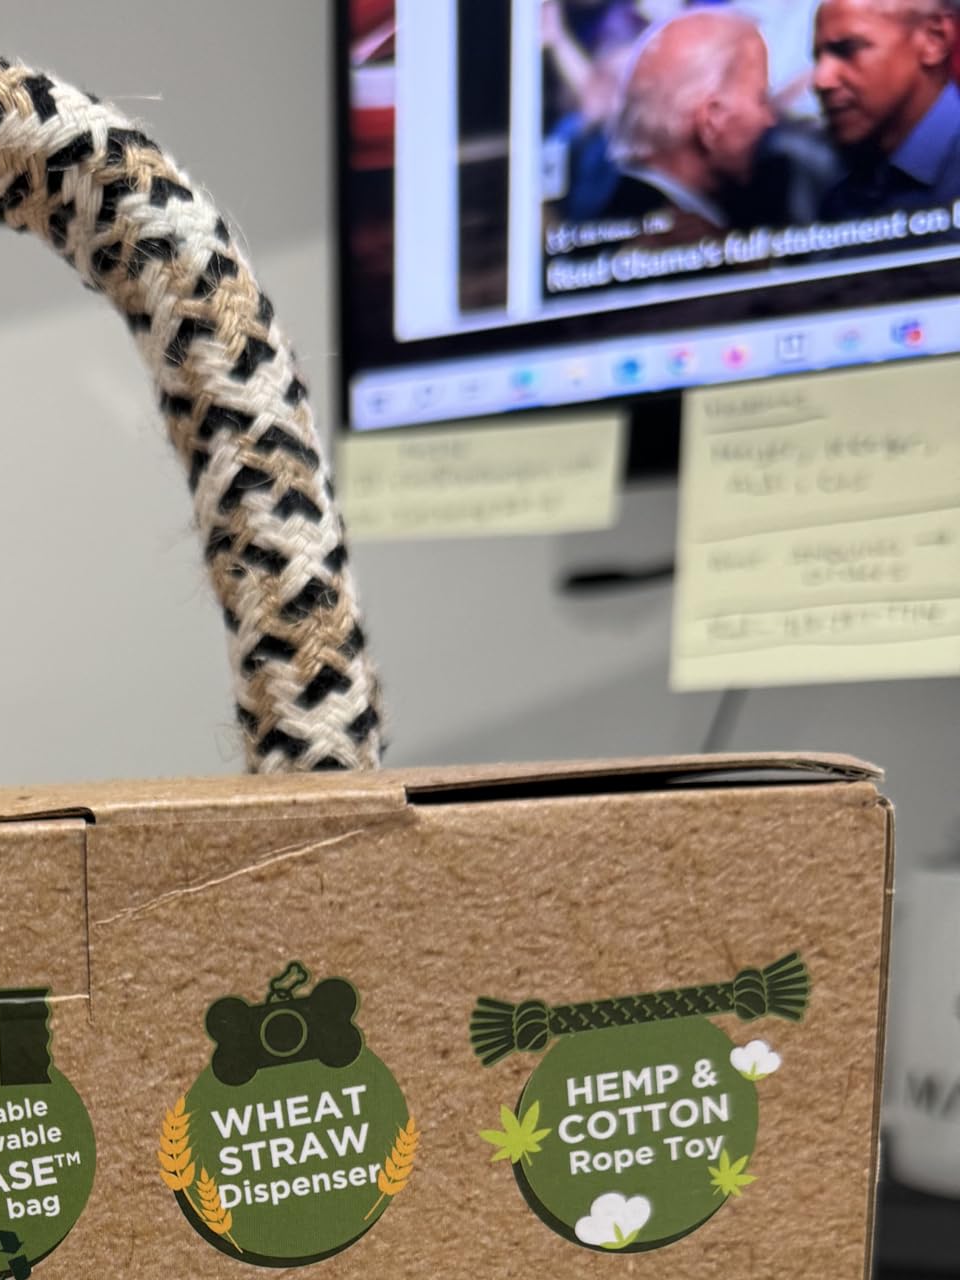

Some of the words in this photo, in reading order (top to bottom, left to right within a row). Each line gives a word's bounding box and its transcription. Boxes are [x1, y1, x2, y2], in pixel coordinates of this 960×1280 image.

[565, 1064, 680, 1107] HEMP
[691, 1059, 719, 1089] &
[210, 1086, 367, 1140] WHEAT
[557, 1094, 730, 1145] COTTON
[219, 1123, 371, 1178] STRAW
[569, 1142, 654, 1176] Rope
[664, 1135, 724, 1162] Toy
[8, 1192, 61, 1221] bag
[216, 1163, 382, 1212] Dispenser
